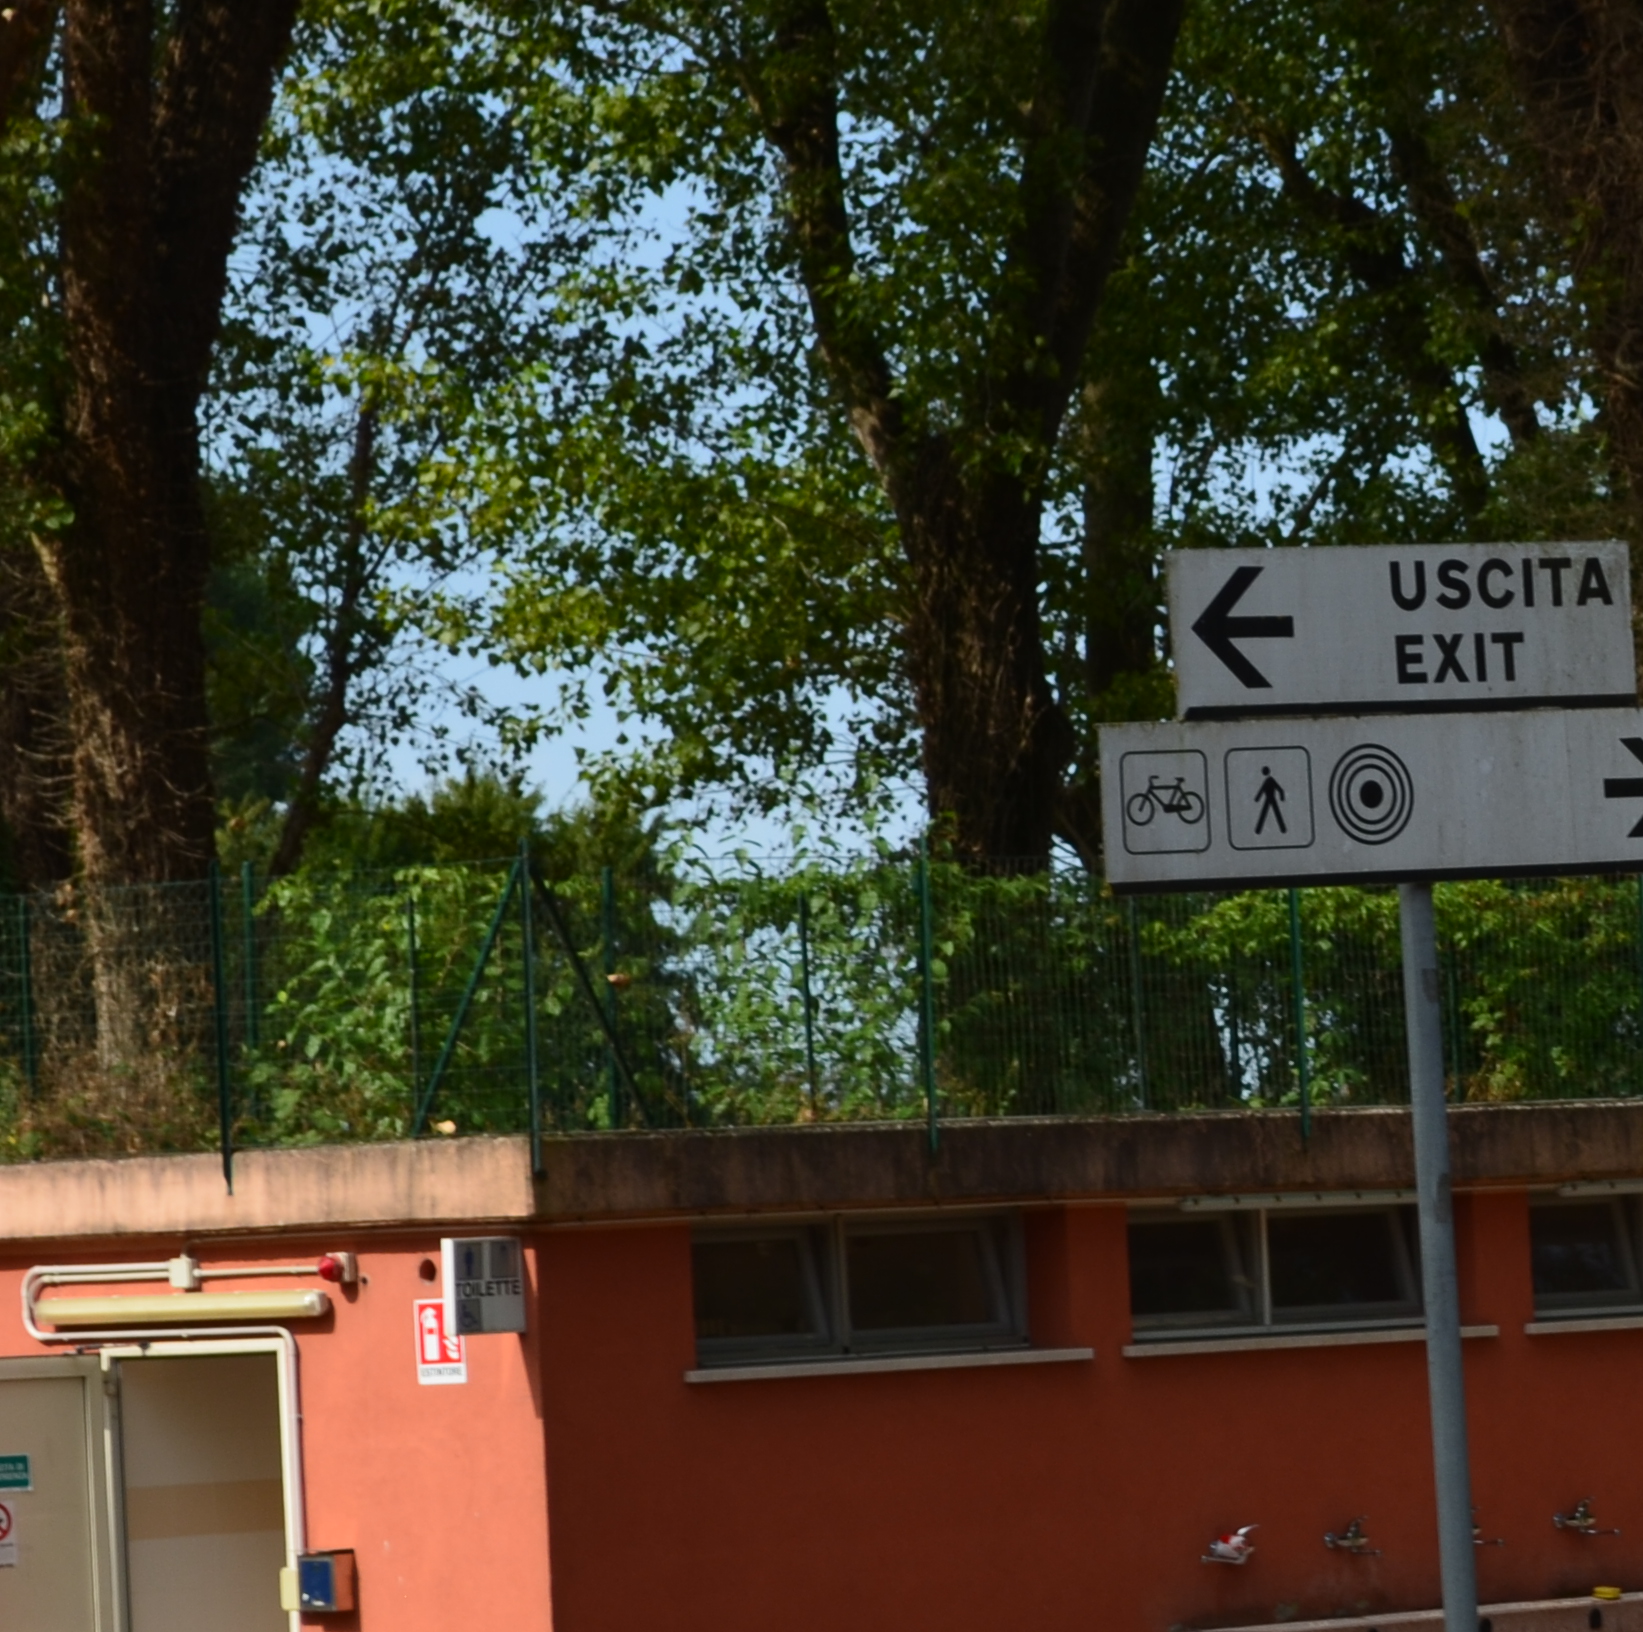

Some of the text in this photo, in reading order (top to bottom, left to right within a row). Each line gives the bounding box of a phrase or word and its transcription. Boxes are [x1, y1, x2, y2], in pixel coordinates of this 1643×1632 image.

[1389, 557, 1613, 611] USCITA
[1395, 632, 1524, 684] EXIT
[455, 1279, 521, 1297] TOILETTE
